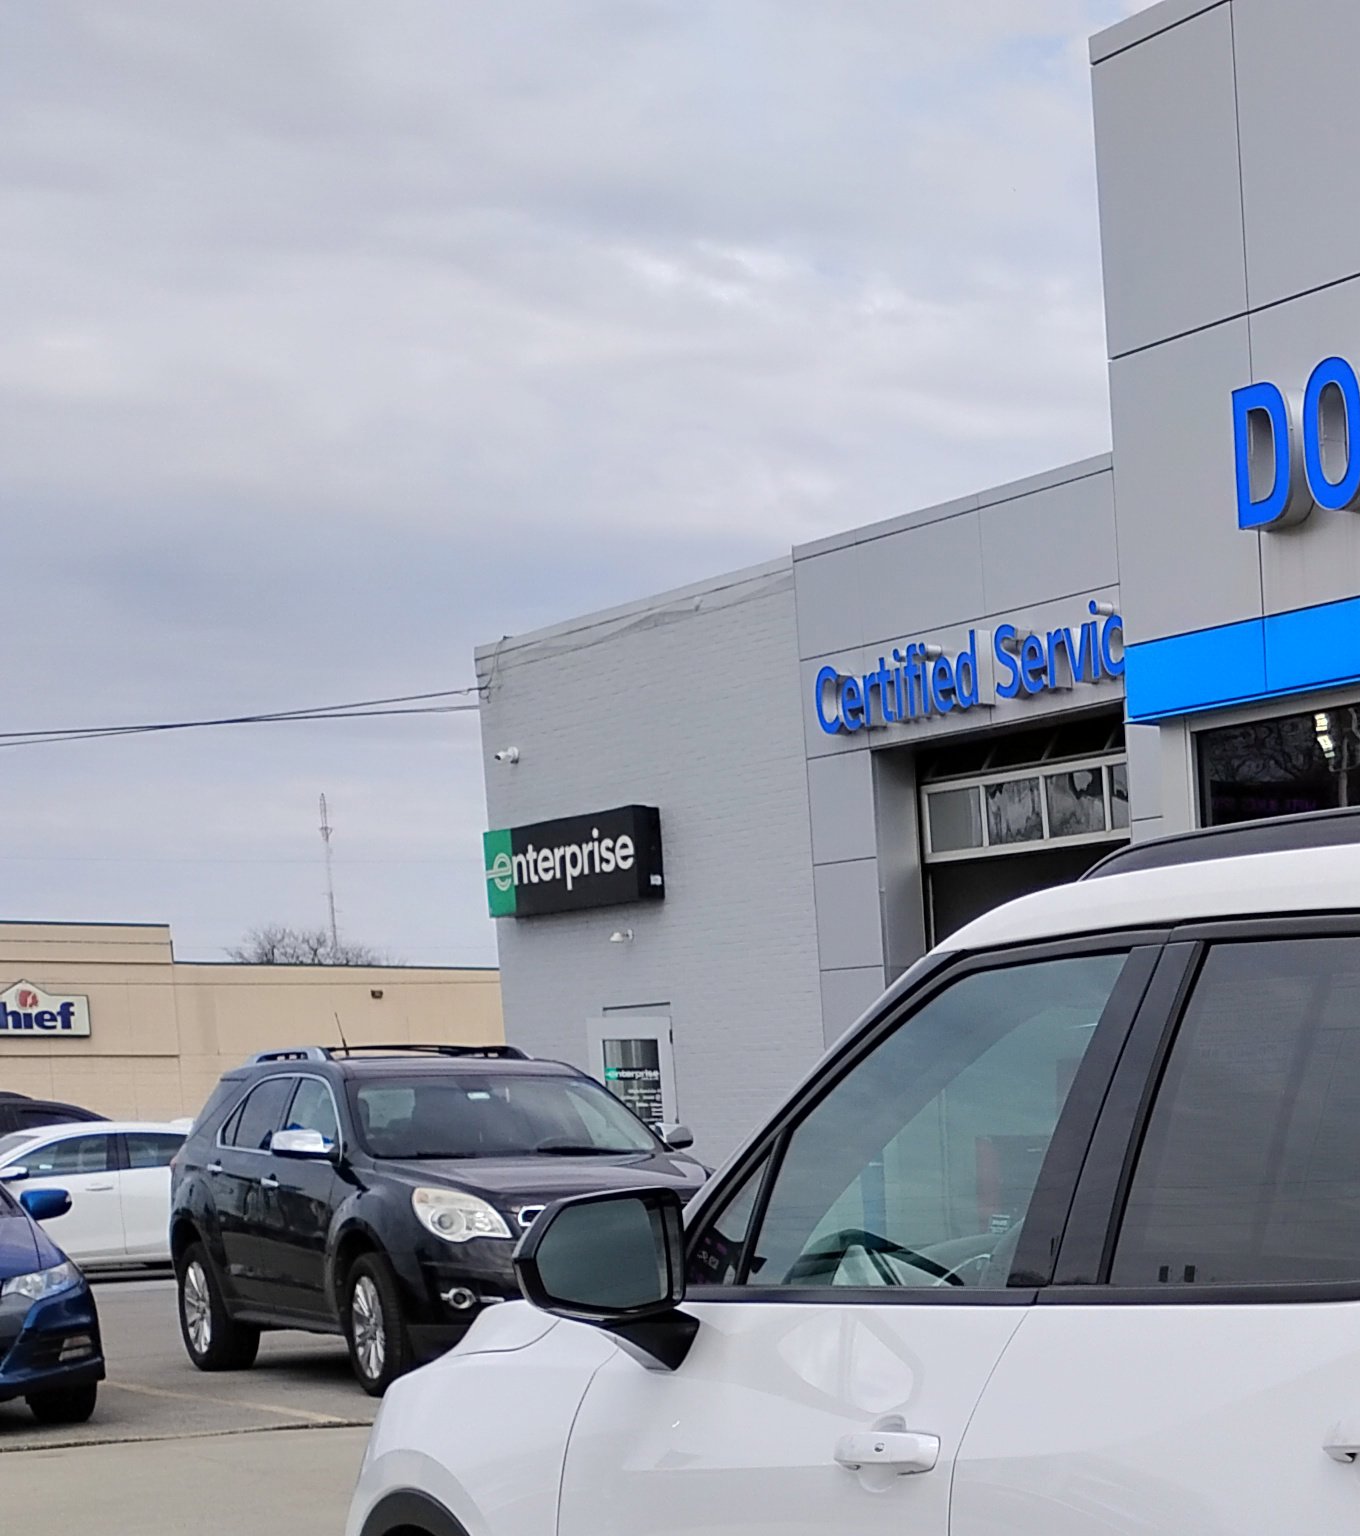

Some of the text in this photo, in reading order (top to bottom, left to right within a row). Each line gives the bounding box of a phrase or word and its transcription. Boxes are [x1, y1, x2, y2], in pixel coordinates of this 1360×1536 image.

[815, 600, 1125, 735] Certified Servic
[485, 828, 635, 891] enterprise
[0, 1001, 75, 1030] hief
